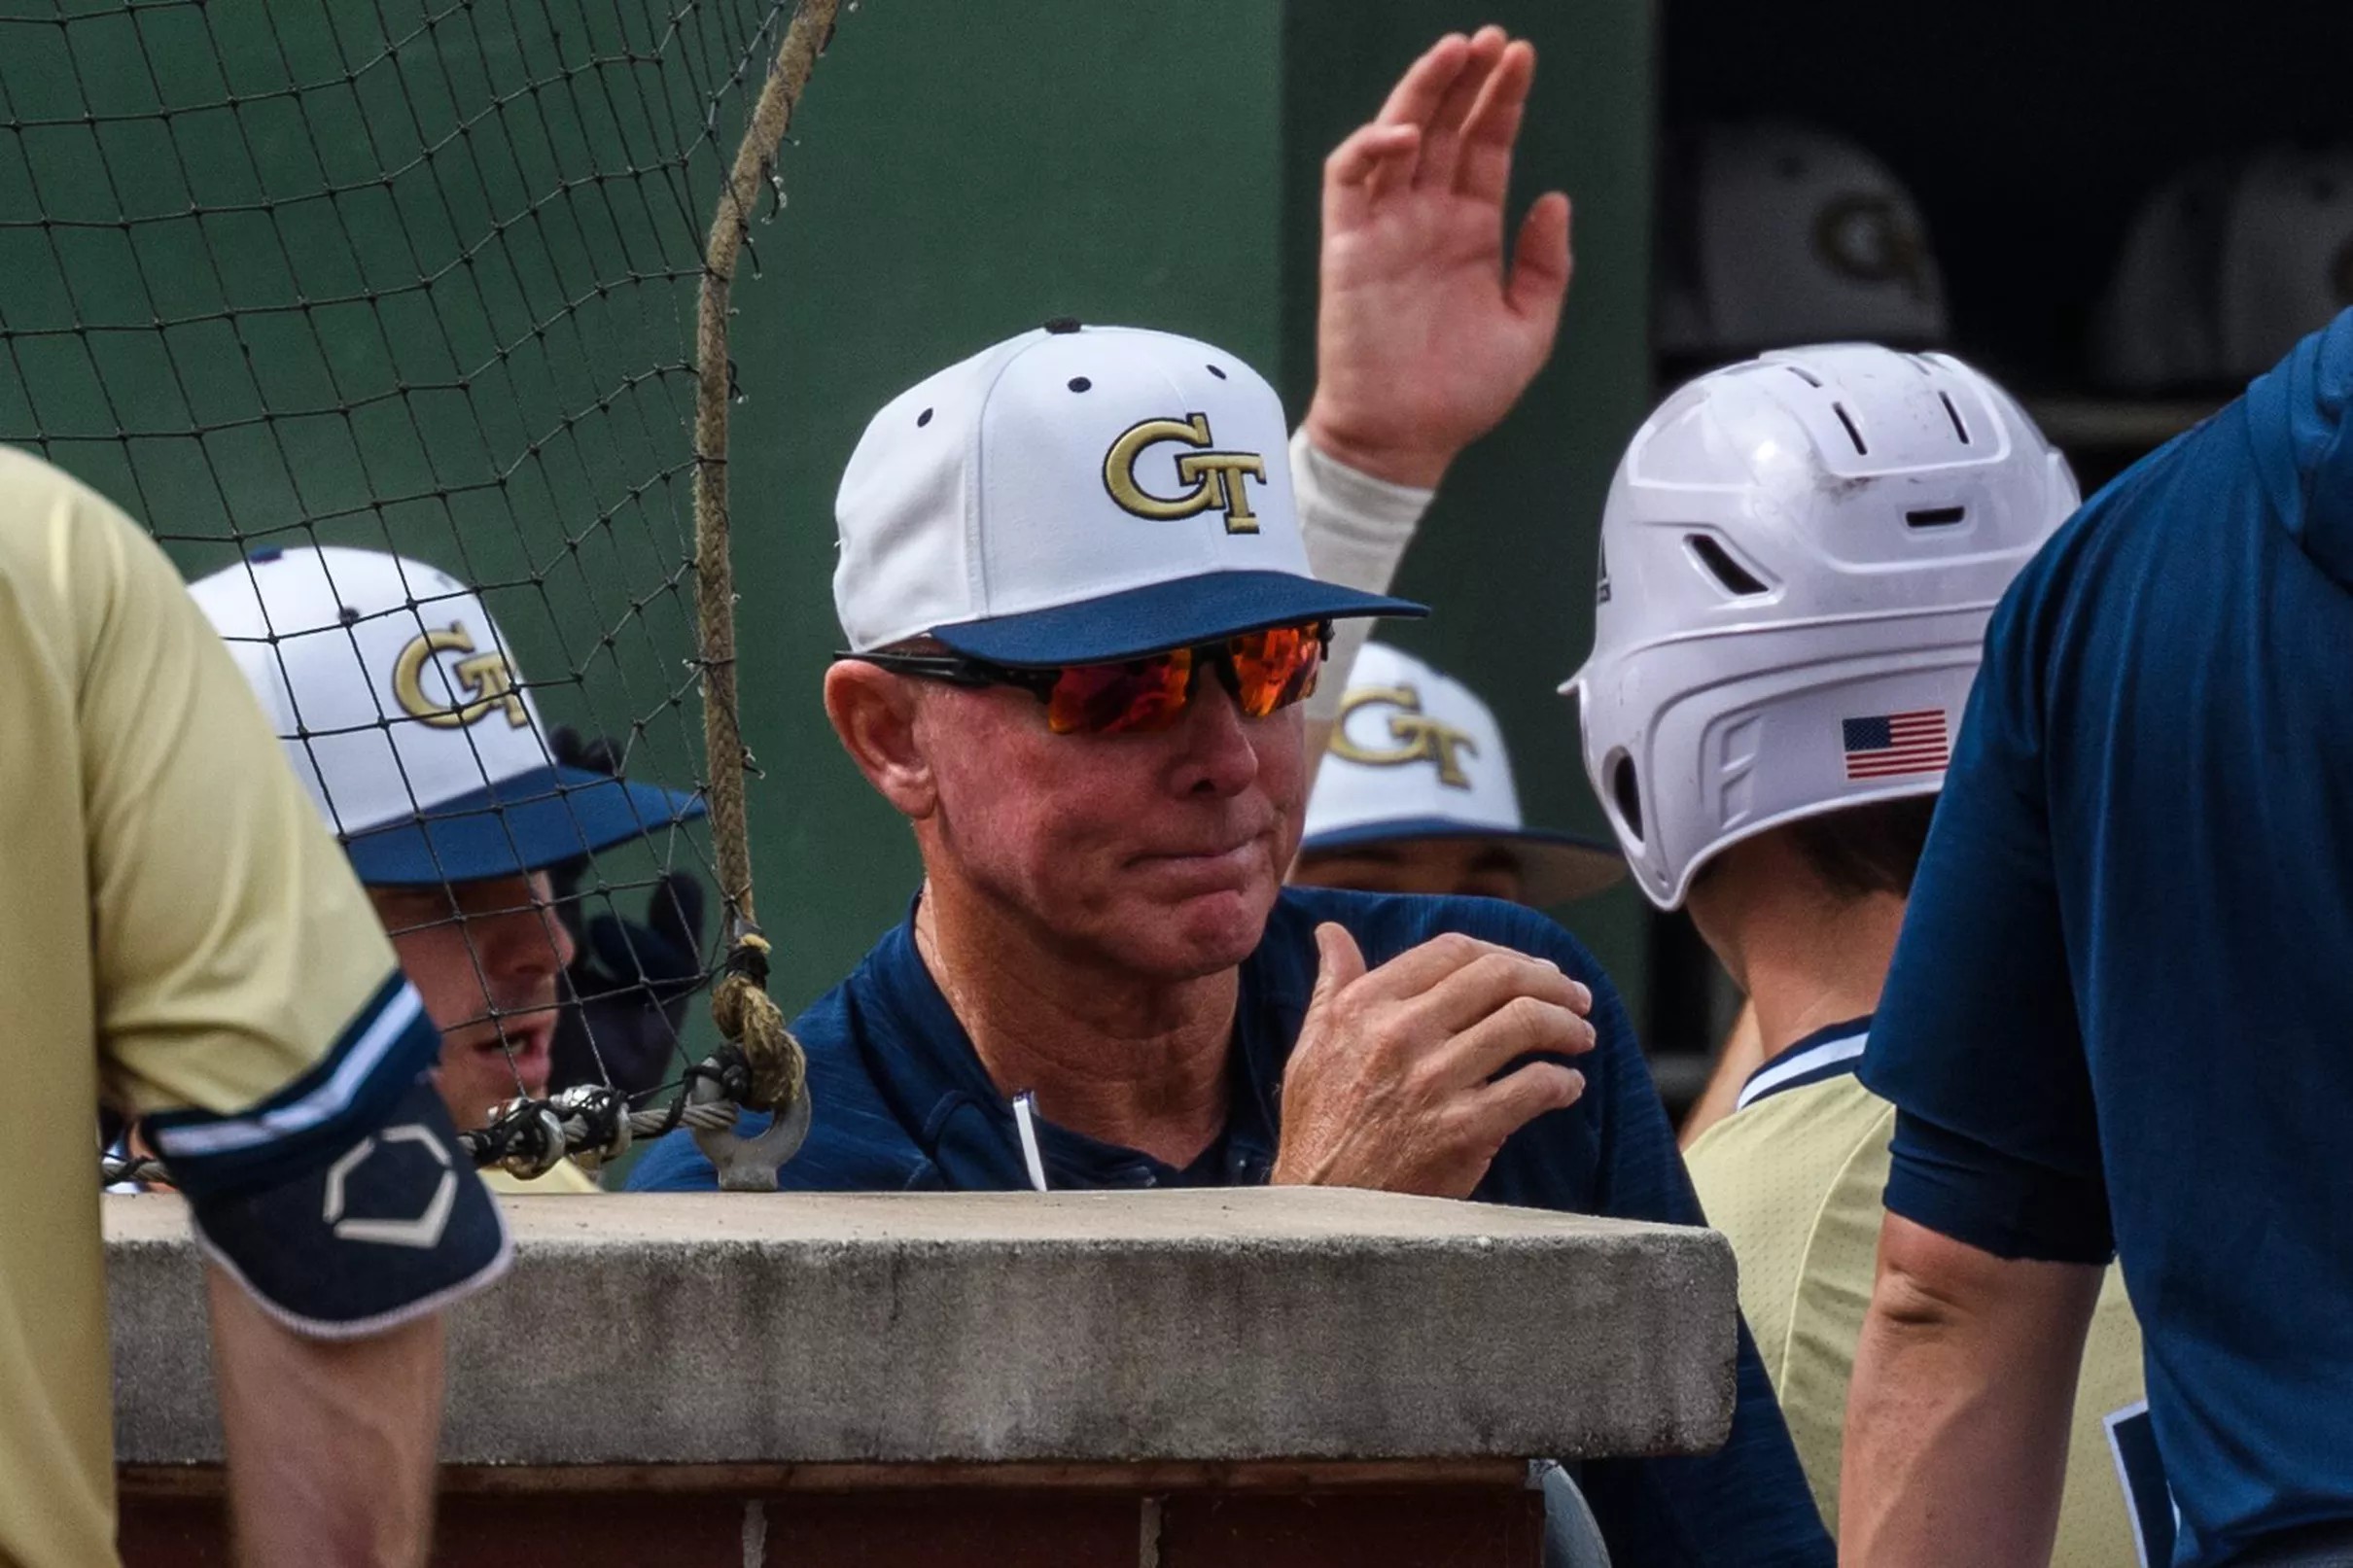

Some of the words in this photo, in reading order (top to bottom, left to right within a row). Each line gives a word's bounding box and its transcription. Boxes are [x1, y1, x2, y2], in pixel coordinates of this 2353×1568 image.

[1102, 412, 1267, 535] GT
[392, 619, 529, 730] GT
[1329, 682, 1479, 791] GT
